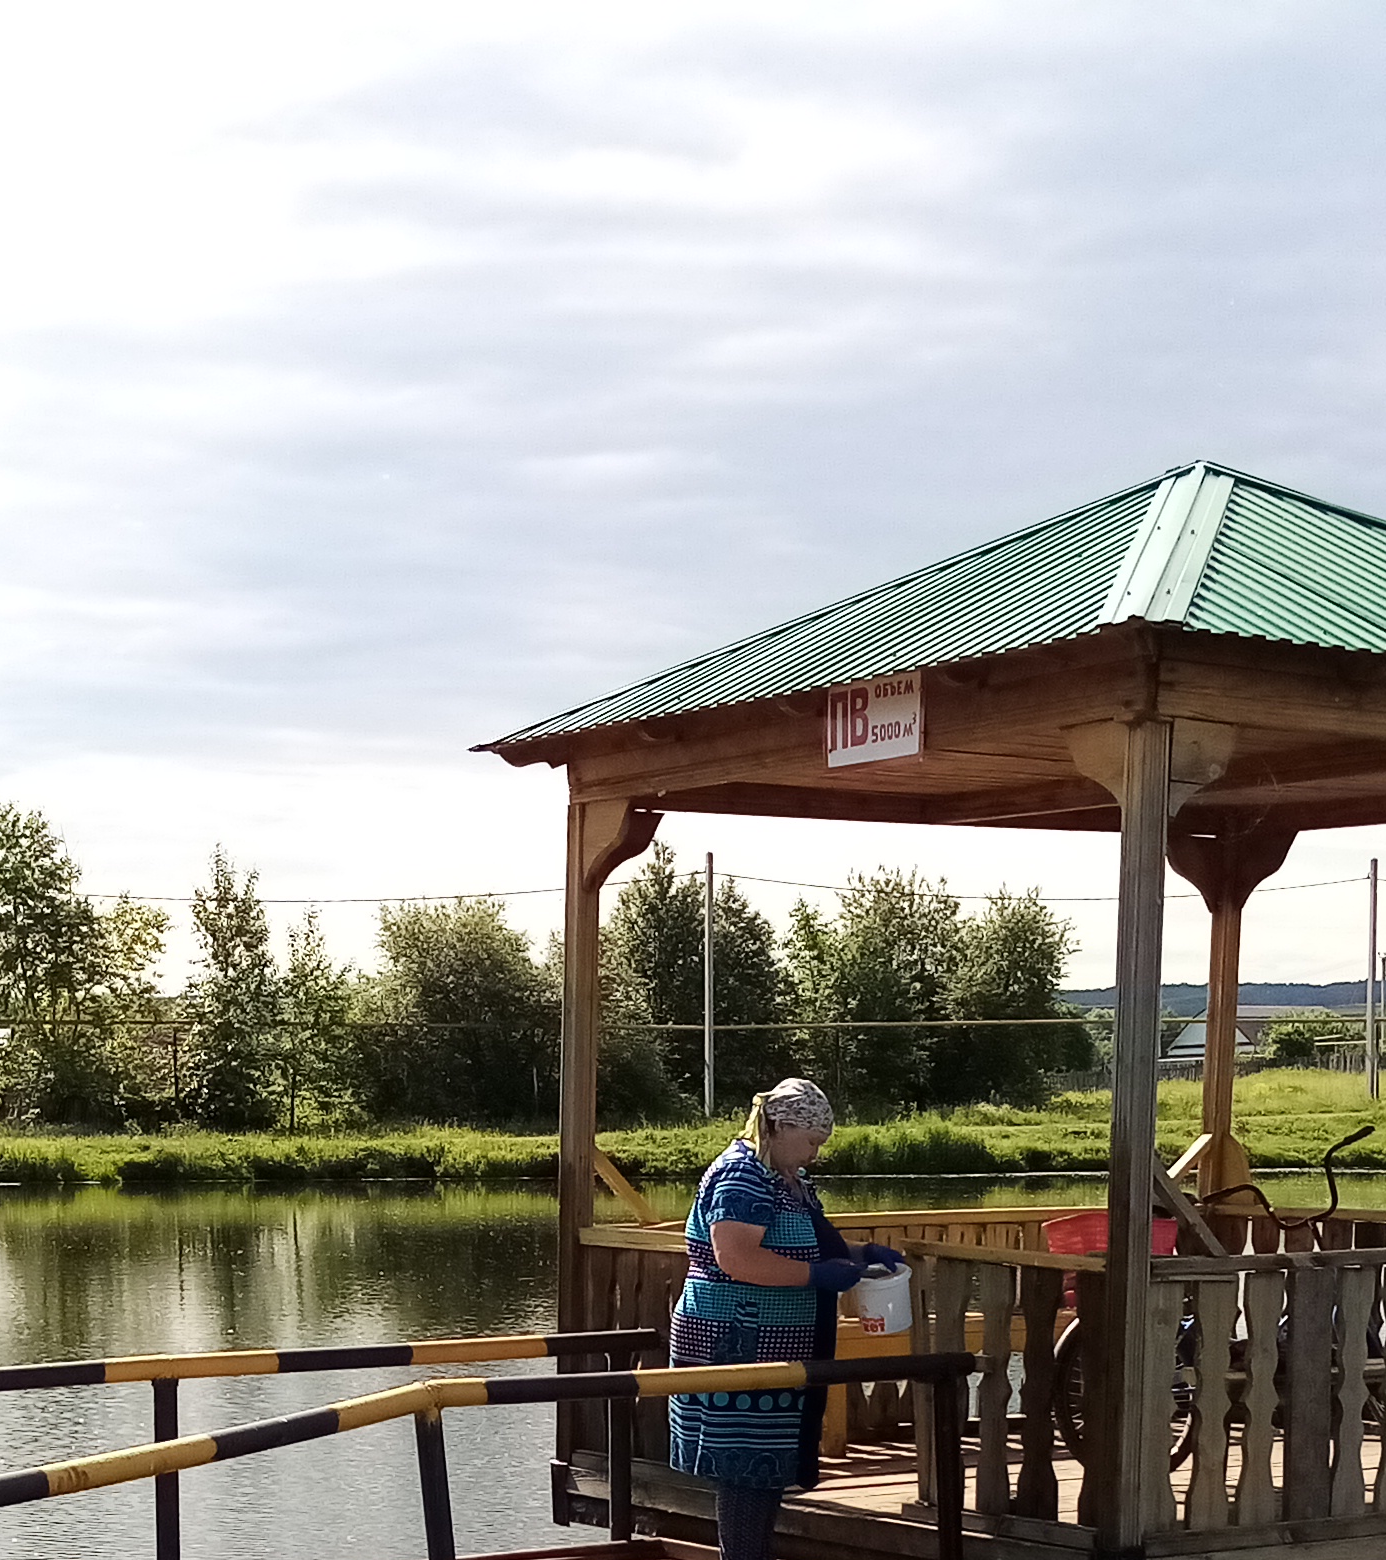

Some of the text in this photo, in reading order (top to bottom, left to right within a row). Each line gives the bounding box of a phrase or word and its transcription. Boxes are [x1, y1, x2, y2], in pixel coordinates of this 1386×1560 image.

[874, 680, 914, 699] ОБЪЕМ
[830, 687, 869, 751] ПВ
[871, 721, 901, 744] 5000
